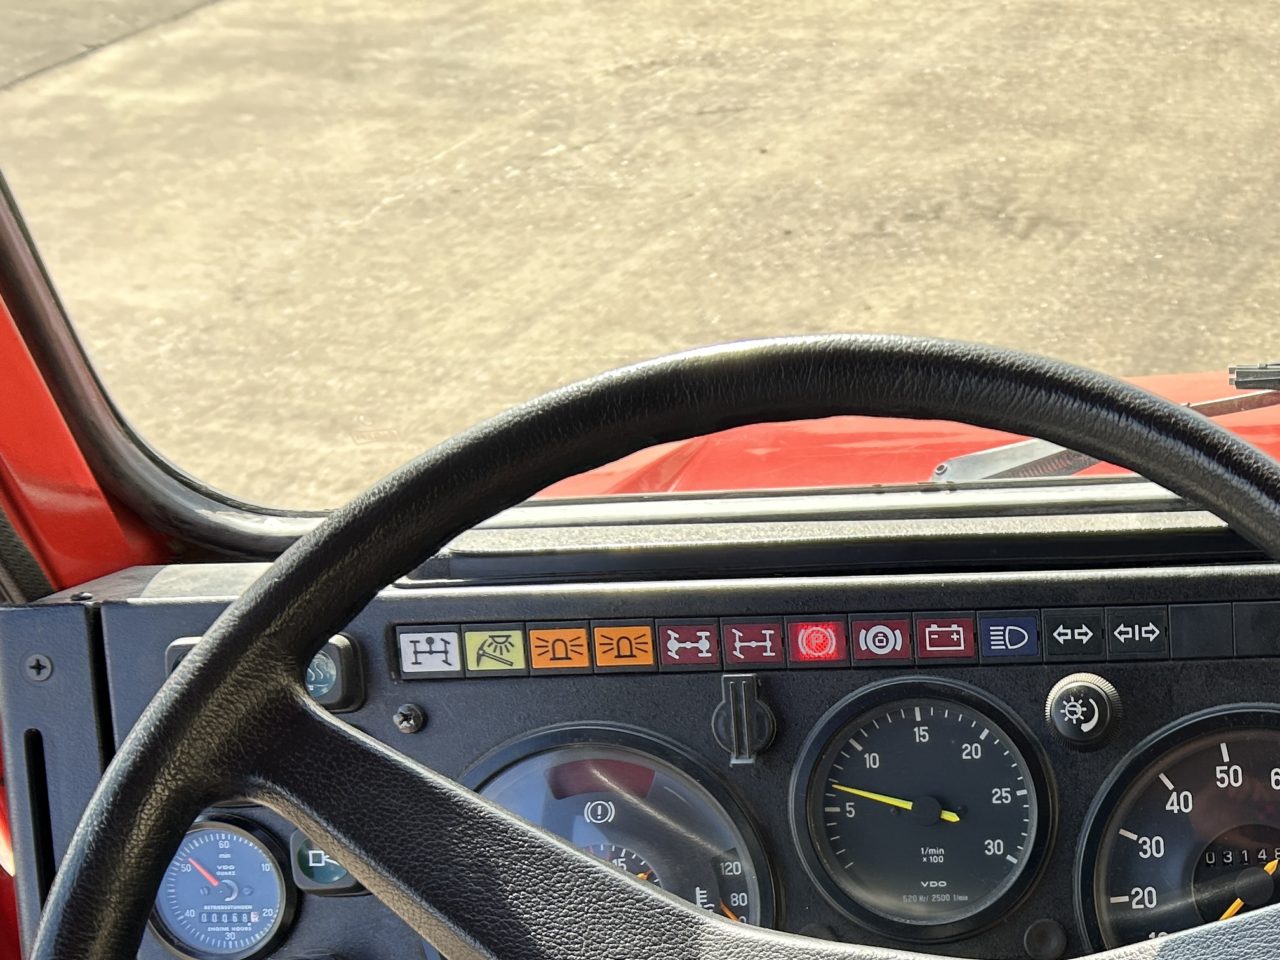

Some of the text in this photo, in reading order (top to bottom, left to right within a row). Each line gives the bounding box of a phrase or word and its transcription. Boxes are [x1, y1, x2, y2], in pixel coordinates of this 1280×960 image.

[913, 727, 930, 743] 15
[961, 744, 982, 760] 20
[864, 753, 880, 769] 10
[1215, 765, 1243, 788] 50
[991, 788, 1012, 804] 25
[1165, 790, 1193, 814] 40
[846, 802, 856, 818] 5
[218, 840, 230, 849] 60
[984, 839, 1004, 855] 30
[1138, 835, 1165, 859] 30
[929, 855, 944, 863] 100
[181, 864, 192, 873] 50
[261, 863, 271, 872] 10
[720, 861, 742, 876] 120
[920, 880, 947, 888] VDO
[730, 892, 748, 907] 80
[1130, 886, 1157, 909] 20
[184, 909, 195, 918] 40
[262, 908, 274, 917] 20
[224, 932, 236, 941] 30
